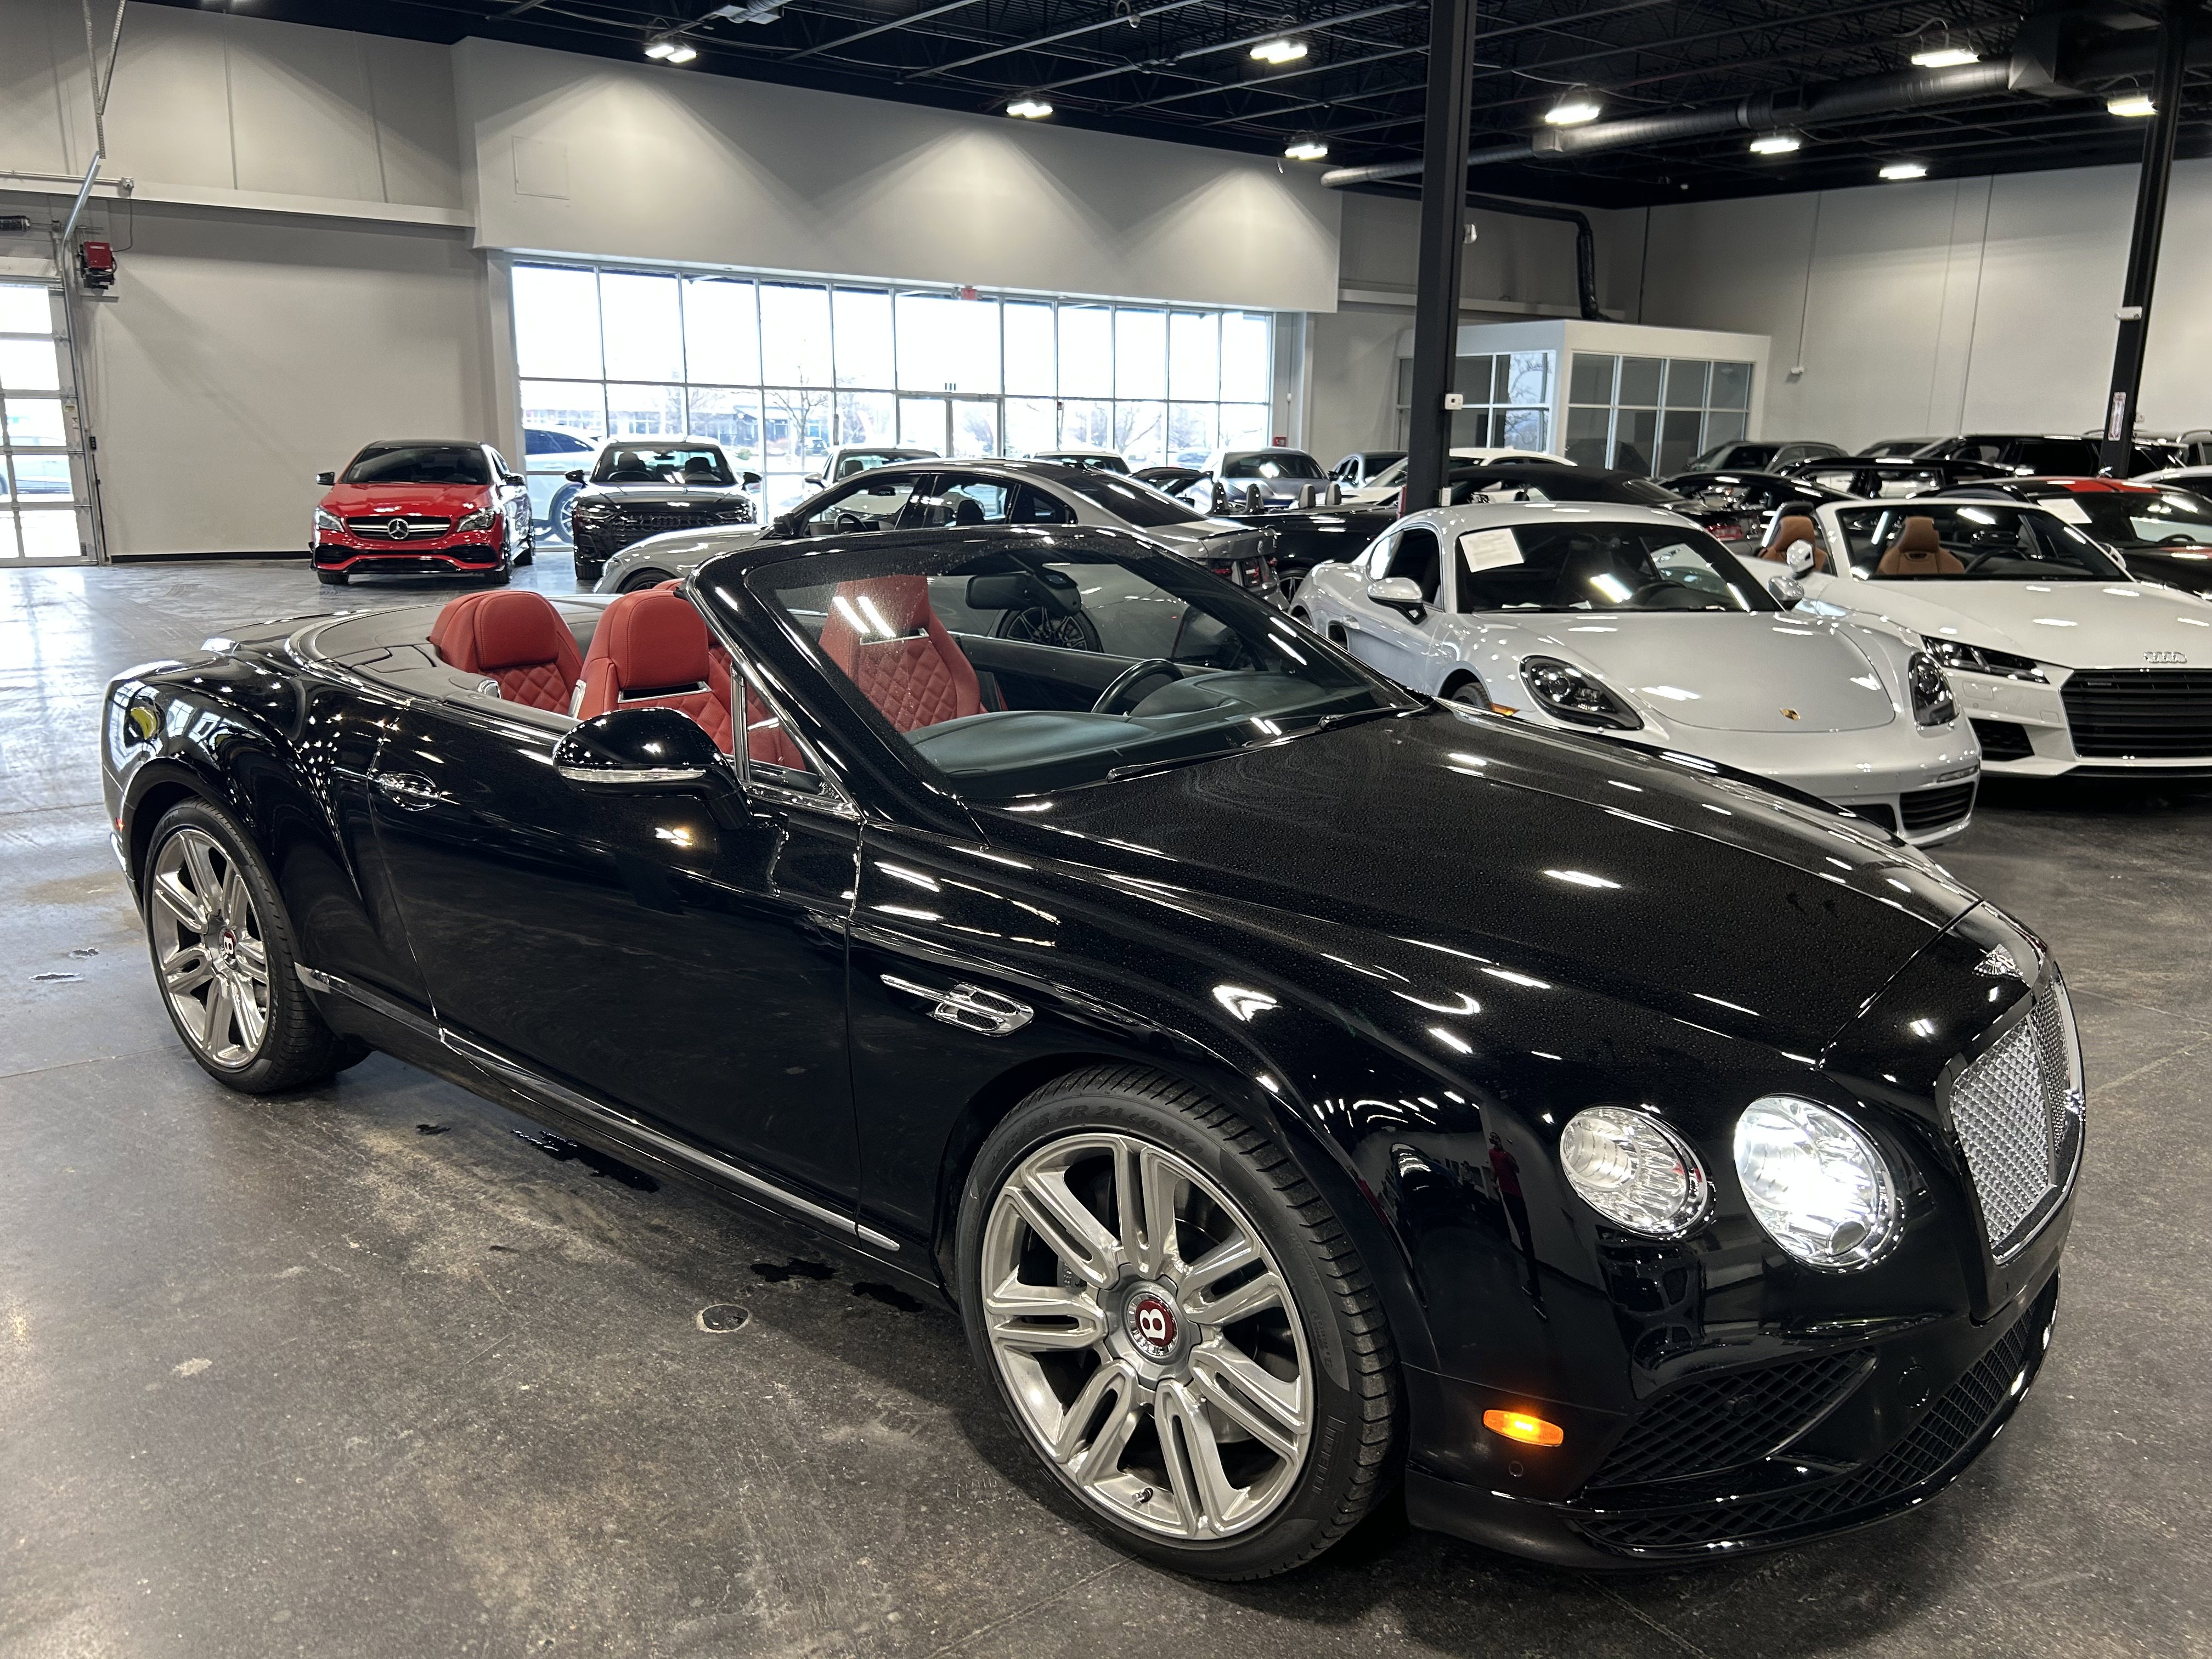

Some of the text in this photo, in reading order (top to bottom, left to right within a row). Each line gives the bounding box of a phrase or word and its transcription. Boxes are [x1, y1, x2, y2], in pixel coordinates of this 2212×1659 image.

[1057, 1105, 1089, 1122] ZR
[1094, 1105, 1124, 1119] 21
[1139, 1308, 1166, 1340] B
